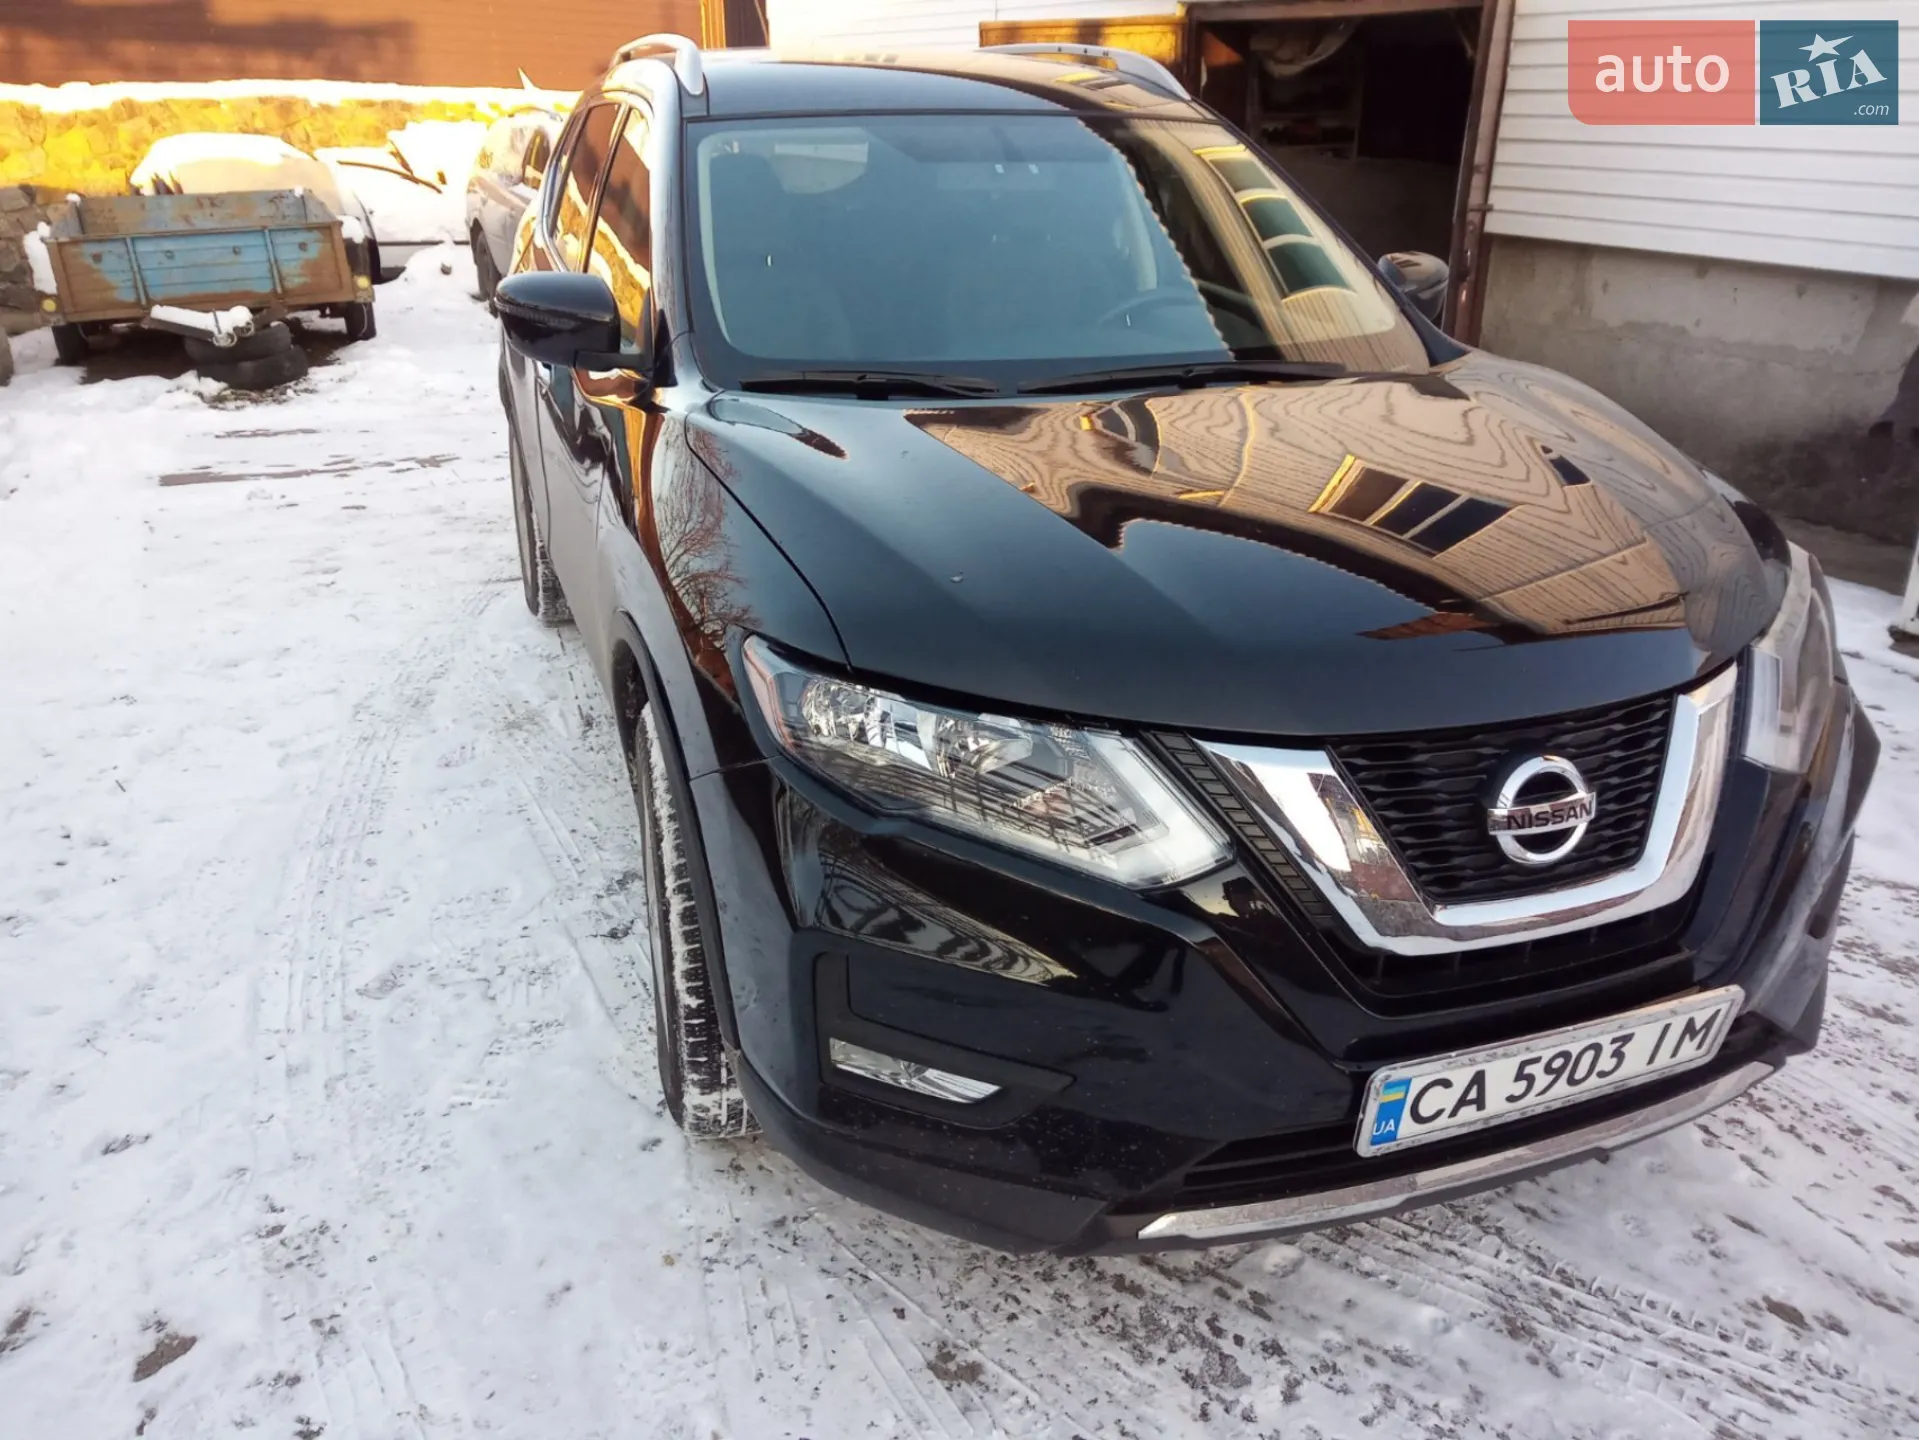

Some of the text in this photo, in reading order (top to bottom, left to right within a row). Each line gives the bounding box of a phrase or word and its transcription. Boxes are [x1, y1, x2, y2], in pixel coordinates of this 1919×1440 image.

[1507, 801, 1592, 830] NISSAN
[1409, 1069, 1487, 1124] CA
[1505, 1032, 1636, 1103] 5903
[1646, 1008, 1722, 1066] IM
[1372, 1121, 1396, 1137] UA
